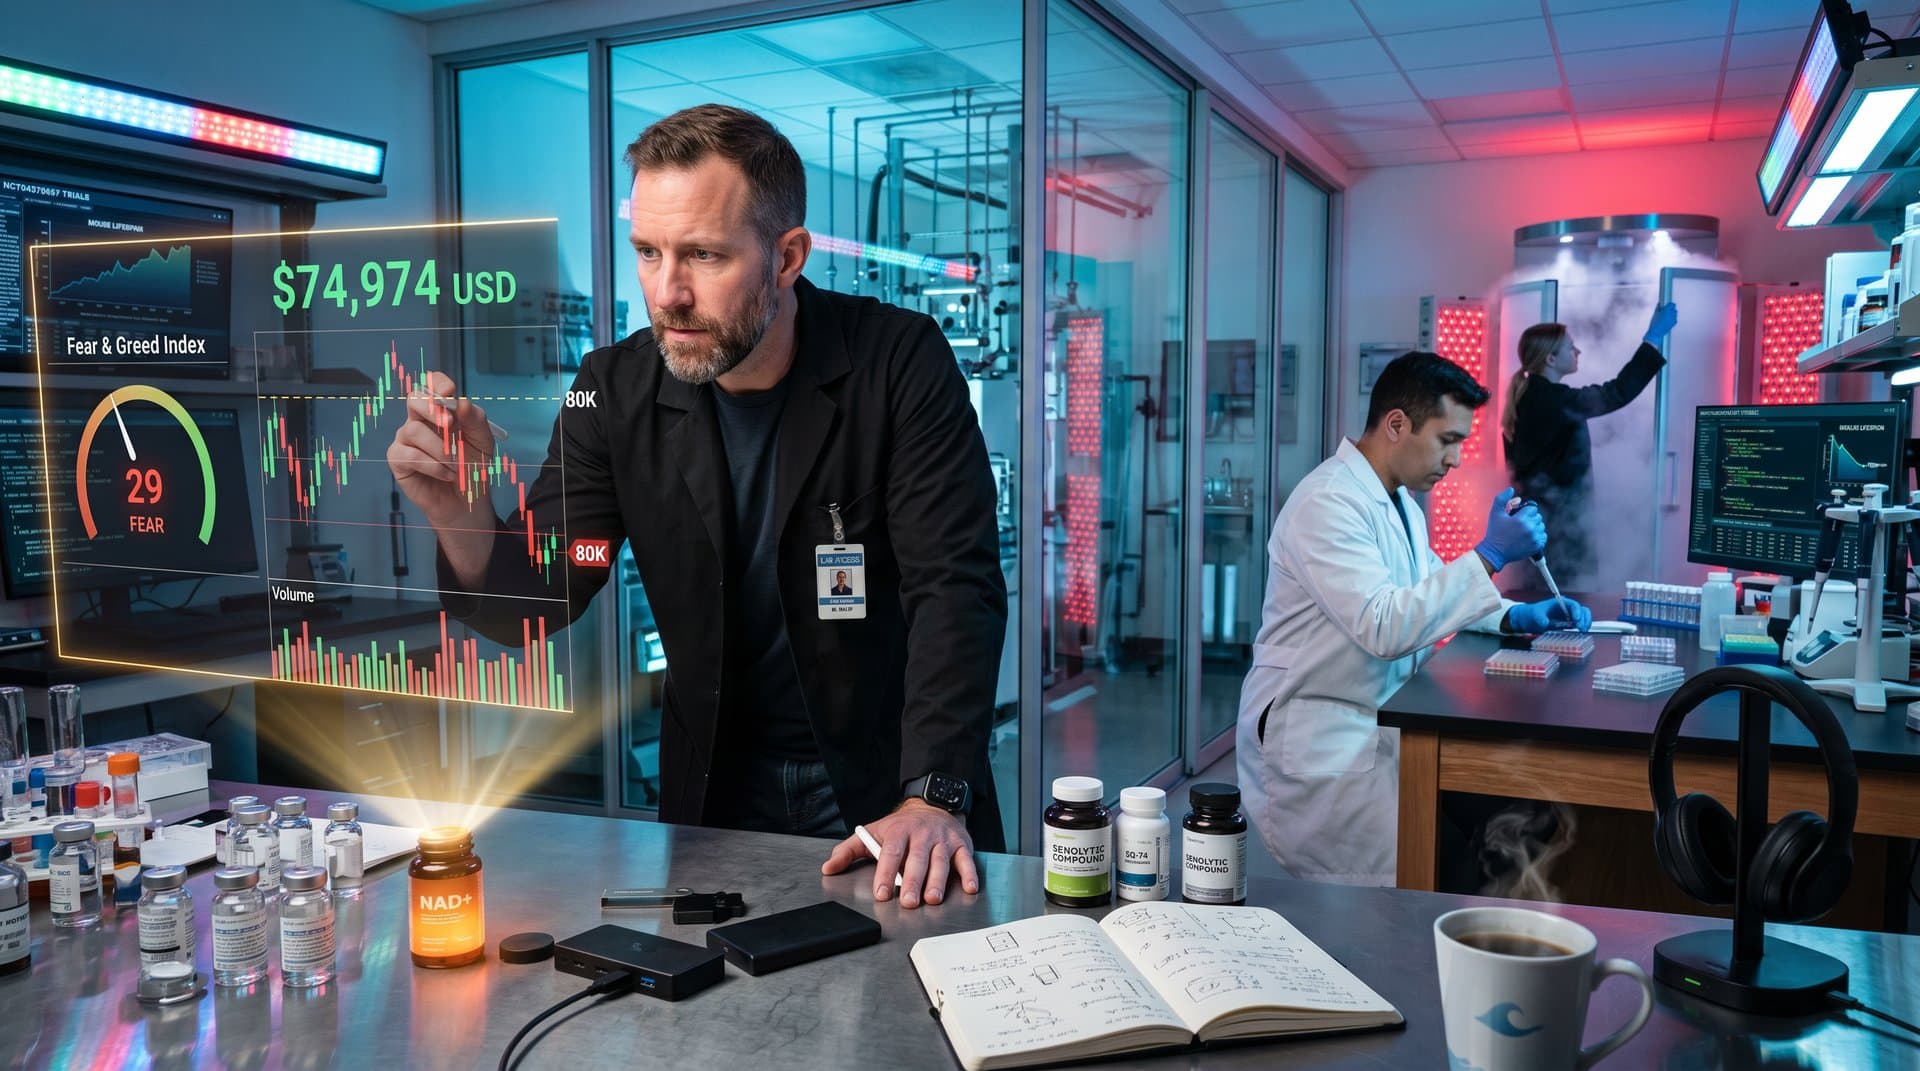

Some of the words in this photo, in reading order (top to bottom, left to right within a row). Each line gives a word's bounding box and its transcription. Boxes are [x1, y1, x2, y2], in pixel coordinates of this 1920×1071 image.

[273, 259, 440, 318] $74,974
[453, 271, 517, 305] USD
[67, 337, 98, 355] Fear
[102, 336, 112, 355] &
[116, 334, 160, 355] Greed
[164, 334, 206, 354] Index
[565, 390, 597, 408] 80K
[125, 468, 163, 504] 29
[129, 516, 165, 534] FEAR
[575, 544, 607, 562] 80K
[272, 586, 315, 603] Volume
[1052, 844, 1105, 855] SENOLYTIC
[1125, 850, 1148, 859] SQ-74
[1052, 853, 1105, 864] COMPOUND
[1186, 854, 1228, 865] SENOLYTIC
[420, 893, 473, 910] NAD+
